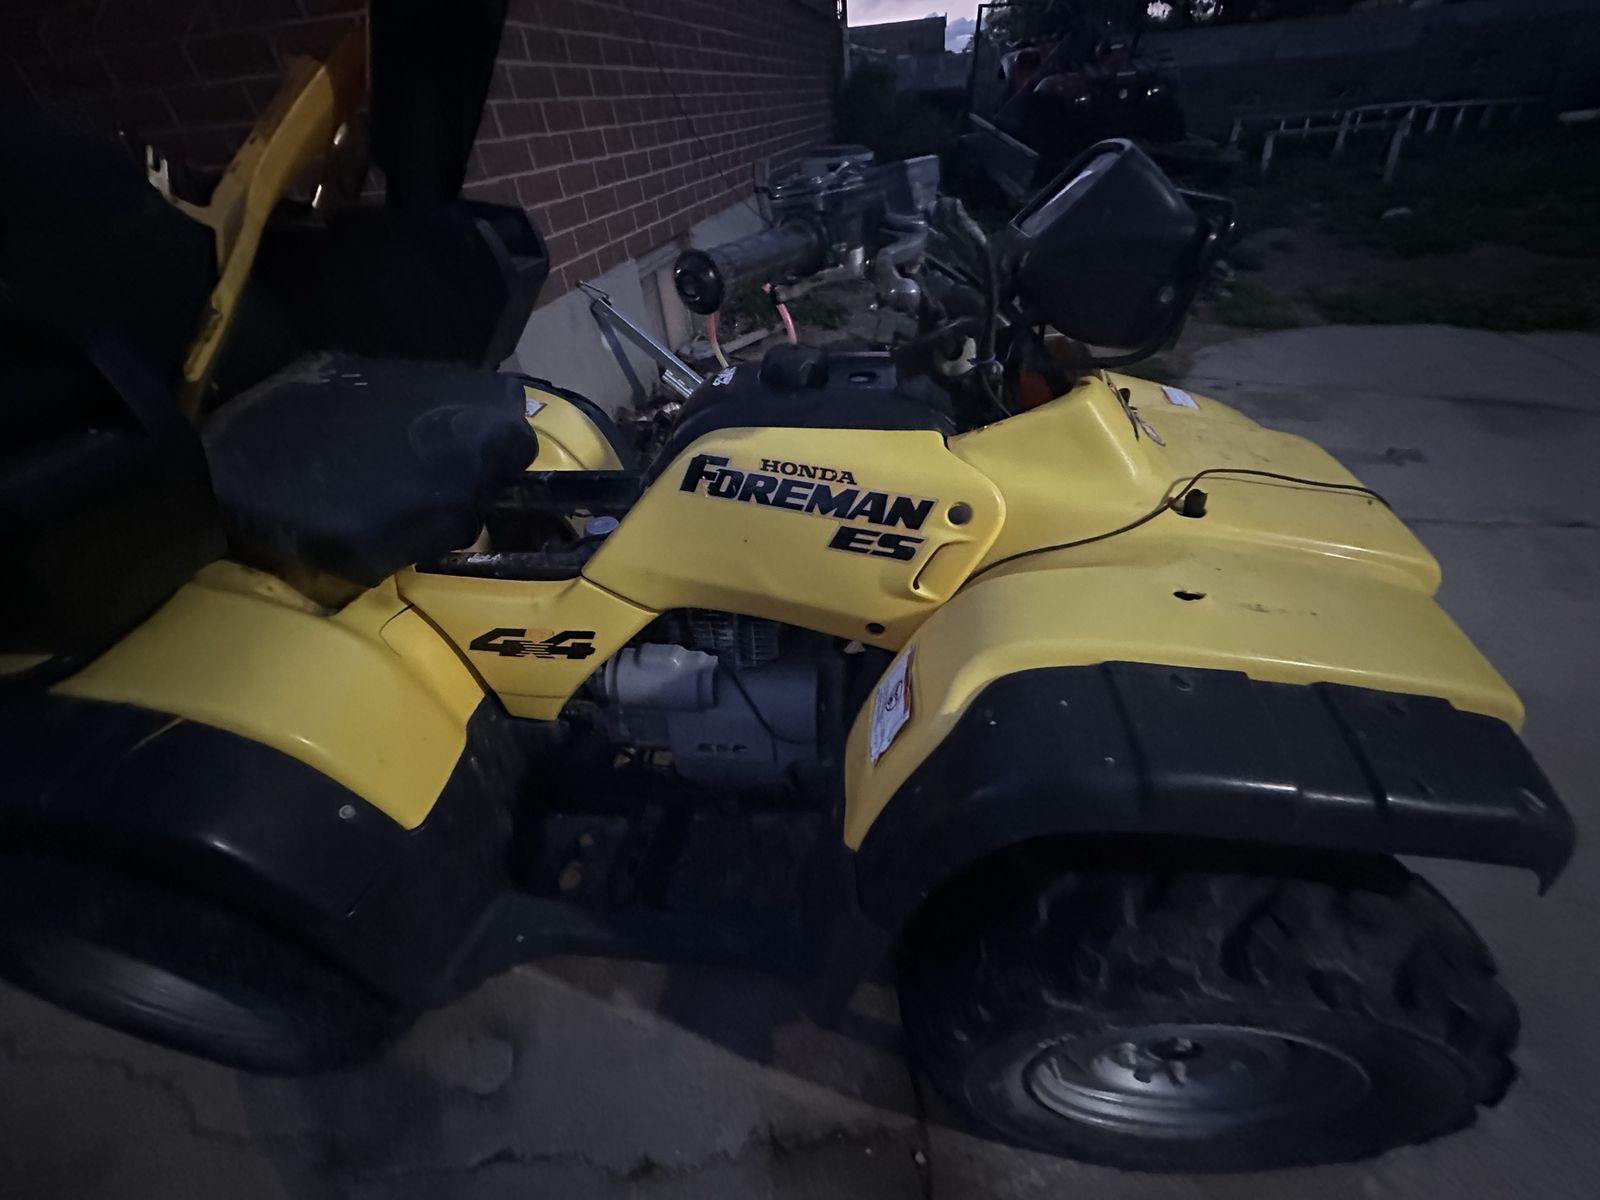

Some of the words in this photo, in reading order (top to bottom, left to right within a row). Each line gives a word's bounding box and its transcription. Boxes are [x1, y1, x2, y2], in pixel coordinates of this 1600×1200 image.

[760, 458, 858, 485] HONDA
[679, 453, 936, 530] FOREMAN
[827, 525, 926, 562] ES
